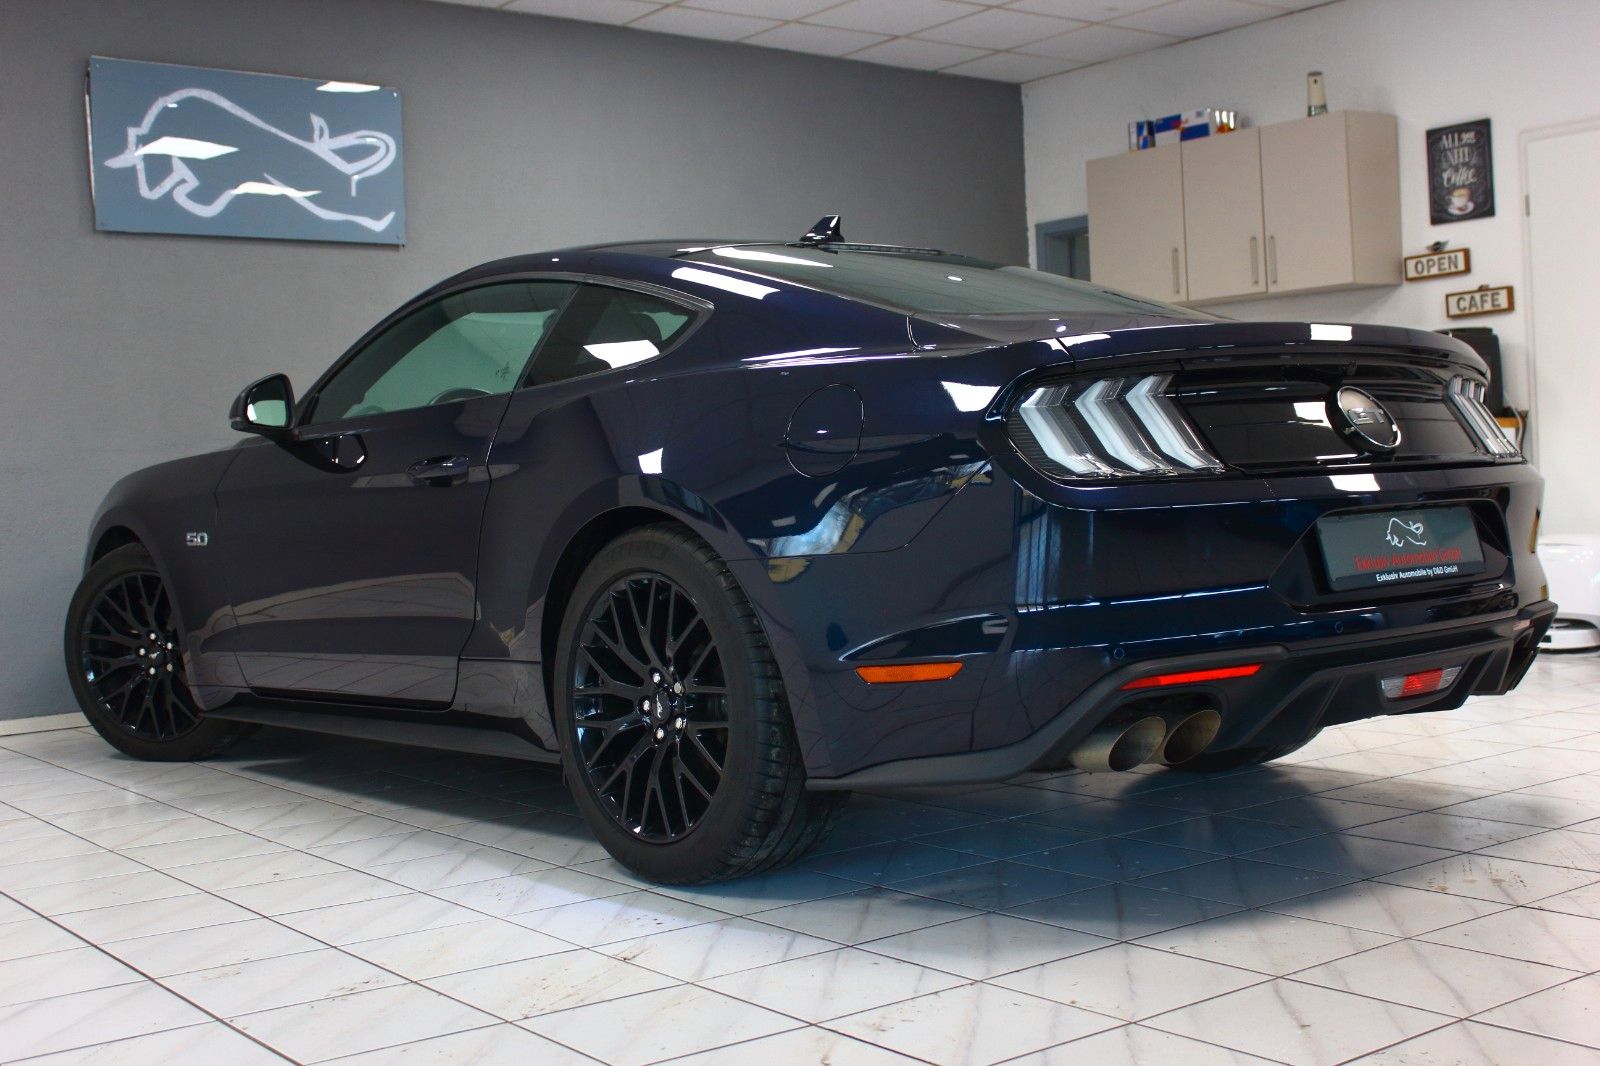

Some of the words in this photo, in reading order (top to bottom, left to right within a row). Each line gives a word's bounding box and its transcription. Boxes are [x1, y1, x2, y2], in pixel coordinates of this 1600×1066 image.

[1414, 254, 1459, 275] OPEN
[1456, 292, 1502, 312] CAFE
[1376, 573, 1398, 582] Exklusiv
[1399, 568, 1427, 579] Automobile
[1427, 568, 1433, 577] by
[1444, 564, 1458, 573] GmbH
